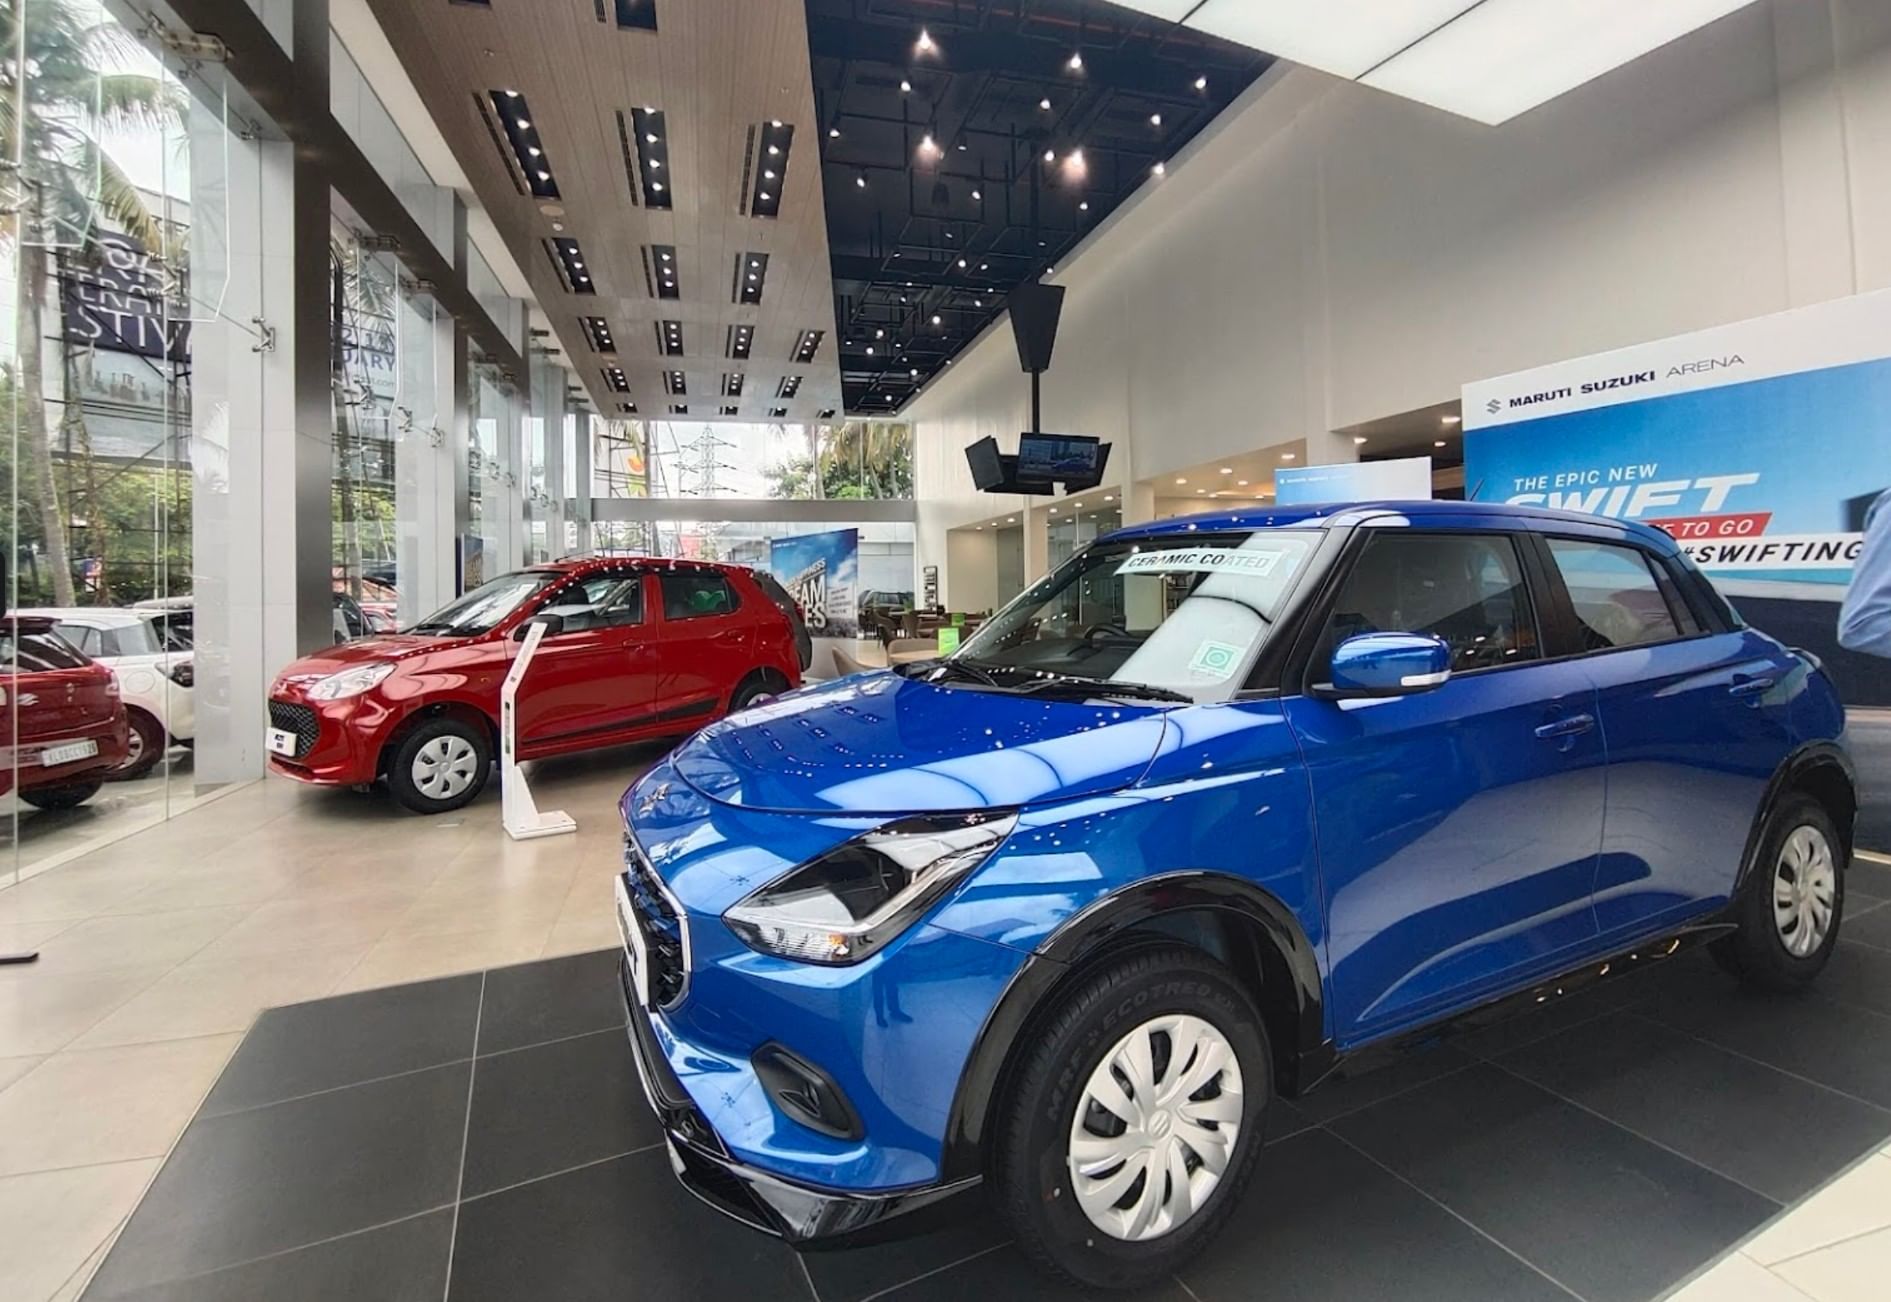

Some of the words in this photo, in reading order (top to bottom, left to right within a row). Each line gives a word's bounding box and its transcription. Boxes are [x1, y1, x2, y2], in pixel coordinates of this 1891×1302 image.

[1509, 387, 1572, 408] MARUTI
[1580, 370, 1656, 394] SUZUKI
[1666, 354, 1745, 378] ARENA
[1514, 475, 1548, 492] THE
[1555, 469, 1600, 487] EPIC
[1608, 463, 1658, 481] NEW
[1682, 521, 1710, 537] TO
[1718, 519, 1754, 536] GO
[1128, 553, 1197, 568] CERAMIC
[1199, 553, 1269, 569] COATED
